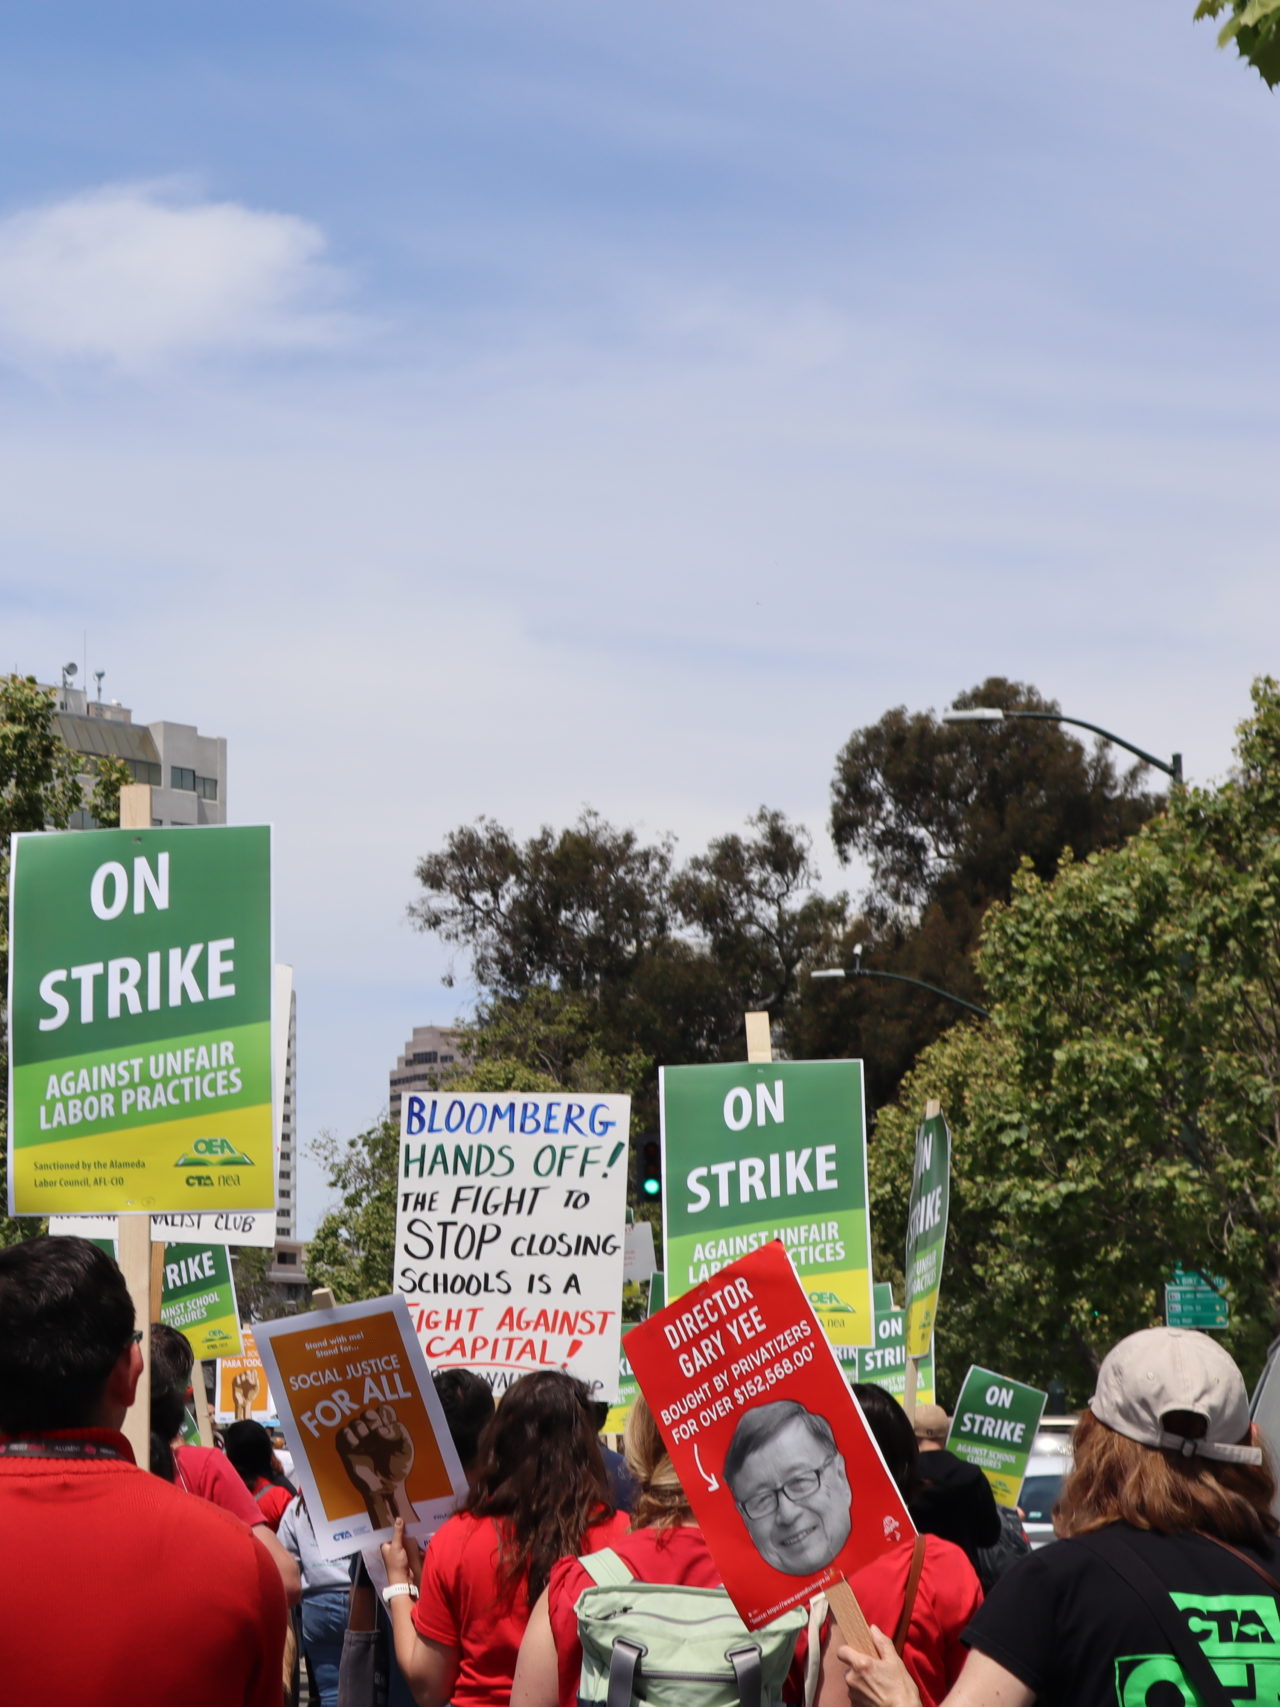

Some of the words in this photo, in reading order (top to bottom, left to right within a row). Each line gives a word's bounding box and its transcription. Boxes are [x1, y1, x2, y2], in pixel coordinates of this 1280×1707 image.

[90, 851, 169, 921] ON
[39, 937, 236, 1032] STRIKE
[45, 1057, 143, 1100] AGAINST
[149, 1041, 235, 1079] UNFAIR
[40, 1092, 115, 1130] LABOR
[121, 1067, 243, 1114] PRACTICES
[723, 1080, 784, 1131] ON
[406, 1096, 616, 1137] BLOOMBERG
[192, 1137, 237, 1156] OEA
[404, 1143, 515, 1179] HANDS
[533, 1141, 625, 1179] OFF!
[34, 1161, 80, 1171] Sanctioned
[81, 1161, 92, 1172] by
[93, 1161, 108, 1170] the
[109, 1160, 146, 1170] Alameda
[185, 1175, 214, 1187] CTA
[217, 1174, 240, 1186] nea
[687, 1144, 838, 1213] STRIKE
[34, 1178, 57, 1188] Labor
[59, 1176, 91, 1188] Council,
[401, 1191, 439, 1212] THE
[451, 1186, 550, 1216] FIGHT
[563, 1190, 590, 1209] TO
[215, 1213, 256, 1233] CLUB
[404, 1218, 502, 1261] STOP
[511, 1233, 621, 1257] CLOSING
[693, 1231, 768, 1262] AGAINST
[773, 1221, 839, 1249] UNFAIR
[165, 1251, 216, 1291] RIKE
[398, 1268, 512, 1296] SCHOOLS
[527, 1273, 552, 1294] IS
[563, 1273, 581, 1295] A
[161, 1305, 184, 1320] AINST
[186, 1291, 219, 1309] SCHOOL
[496, 1306, 616, 1336] AGAINST
[663, 1277, 754, 1350] DIRECTOR
[827, 1316, 845, 1329] nea
[878, 1317, 902, 1339] ON
[305, 1340, 328, 1350] Stand
[330, 1335, 347, 1346] with
[349, 1331, 364, 1341] me!
[316, 1348, 339, 1358] Stand
[426, 1336, 583, 1368] CAPITAL!
[678, 1330, 726, 1378] GARY
[726, 1306, 767, 1345] YEE
[222, 1360, 241, 1368] PARA
[289, 1363, 342, 1391] SOCIAL
[345, 1354, 400, 1380] JUSTICE
[660, 1382, 712, 1426] BOUGHT
[713, 1370, 730, 1392] BY
[730, 1320, 812, 1380] PRIVATIZERS
[864, 1345, 905, 1371] STRI
[300, 1388, 360, 1439] FOR
[363, 1373, 412, 1405] ALL
[985, 1385, 1014, 1409] ON
[671, 1418, 700, 1445] FOR
[699, 1396, 734, 1427] OVER
[960, 1412, 1026, 1443] STRIKE
[956, 1443, 988, 1457] AGAINST
[988, 1449, 1017, 1464] SCHOOL
[967, 1456, 1003, 1470] CLOSURES
[332, 1530, 353, 1541] CTA
[1177, 1608, 1276, 1643] CTA
